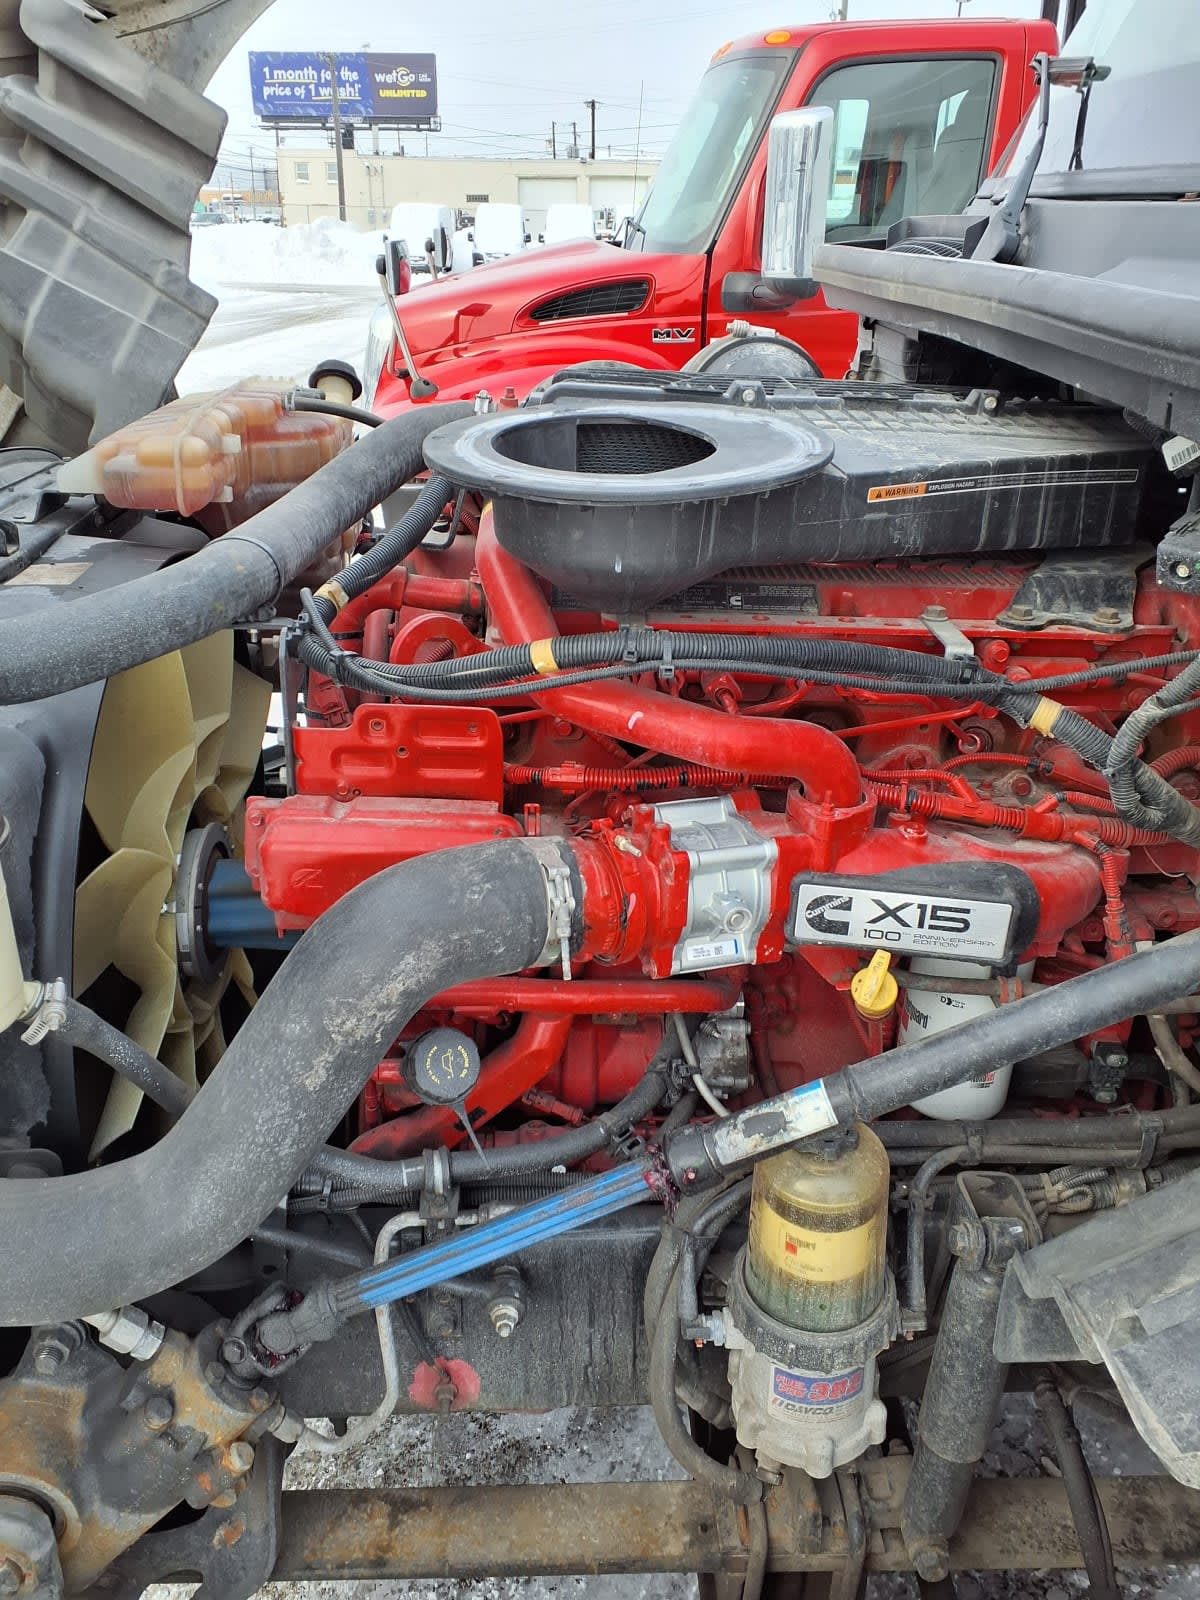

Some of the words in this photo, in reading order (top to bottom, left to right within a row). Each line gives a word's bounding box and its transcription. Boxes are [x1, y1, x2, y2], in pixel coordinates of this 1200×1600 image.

[263, 66, 270, 80] 1
[273, 65, 318, 80] month
[321, 69, 338, 83] fo
[341, 66, 360, 82] the
[374, 69, 416, 84] wetGo
[263, 84, 292, 100] price
[294, 85, 306, 99] of
[309, 84, 316, 97] 1
[379, 89, 428, 98] UNLIMITED
[652, 327, 696, 340] MV
[885, 485, 920, 498] WARNING
[928, 481, 956, 492] EXPLOSION
[956, 480, 976, 490] HAZARD
[806, 894, 851, 919] Cummins
[866, 898, 971, 934] X15
[912, 939, 959, 949] EDITION
[913, 933, 999, 947] ANNIVERSARY
